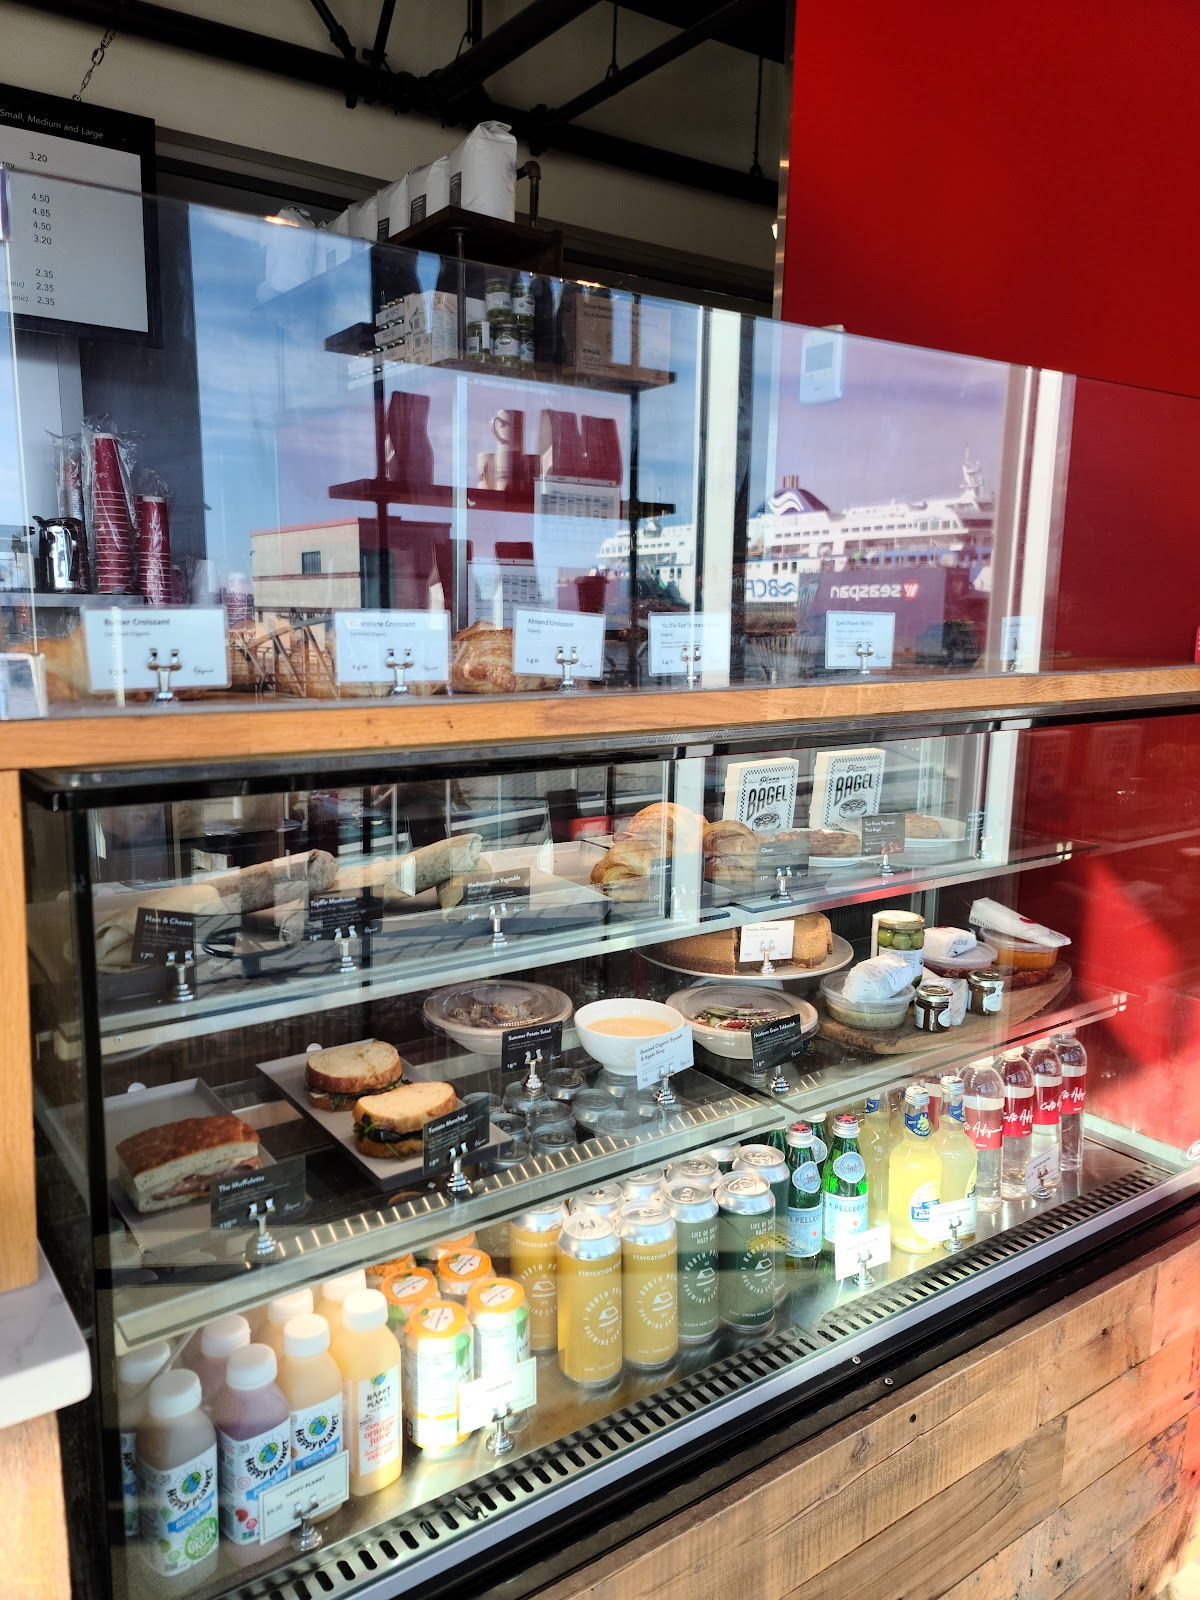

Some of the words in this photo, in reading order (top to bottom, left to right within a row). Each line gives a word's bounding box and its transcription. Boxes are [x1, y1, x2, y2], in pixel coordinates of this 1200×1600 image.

[28, 114, 61, 129] Medium
[63, 124, 79, 133] and
[81, 126, 104, 140] Large
[29, 151, 48, 163] 3.20
[31, 193, 50, 204] 4.50
[32, 207, 51, 218] 4.85
[33, 221, 51, 231] 4.50
[33, 234, 52, 245] 3.20
[35, 268, 54, 279] 2.35
[36, 282, 55, 293] 2.35
[36, 296, 55, 306] 2.35
[385, 620, 416, 628] Croissant
[527, 618, 549, 626] Almond
[549, 620, 574, 628] Croissant
[834, 773, 873, 807] BAGEL
[746, 785, 787, 822] BAGEL
[539, 1027, 552, 1036] Salad
[515, 1238, 548, 1248] STAYCATION
[632, 1252, 667, 1261] STAYCATION
[743, 1242, 765, 1263] NORTH
[684, 1252, 706, 1272] NORTH
[520, 1264, 543, 1281] NORTH
[578, 1266, 613, 1277] STAYCATION
[640, 1275, 663, 1296] NORTH
[741, 1274, 764, 1295] BREWING
[585, 1290, 609, 1313] NORTH
[683, 1283, 706, 1304] BREWING
[584, 1325, 609, 1346] BREWING
[366, 1386, 391, 1402] HAPPY
[364, 1420, 395, 1439] orange
[295, 1428, 318, 1451] Happy
[369, 1431, 391, 1448] juice
[245, 1457, 269, 1480] Happy
[285, 1486, 304, 1498] HAPPY
[304, 1474, 325, 1488] PLANET
